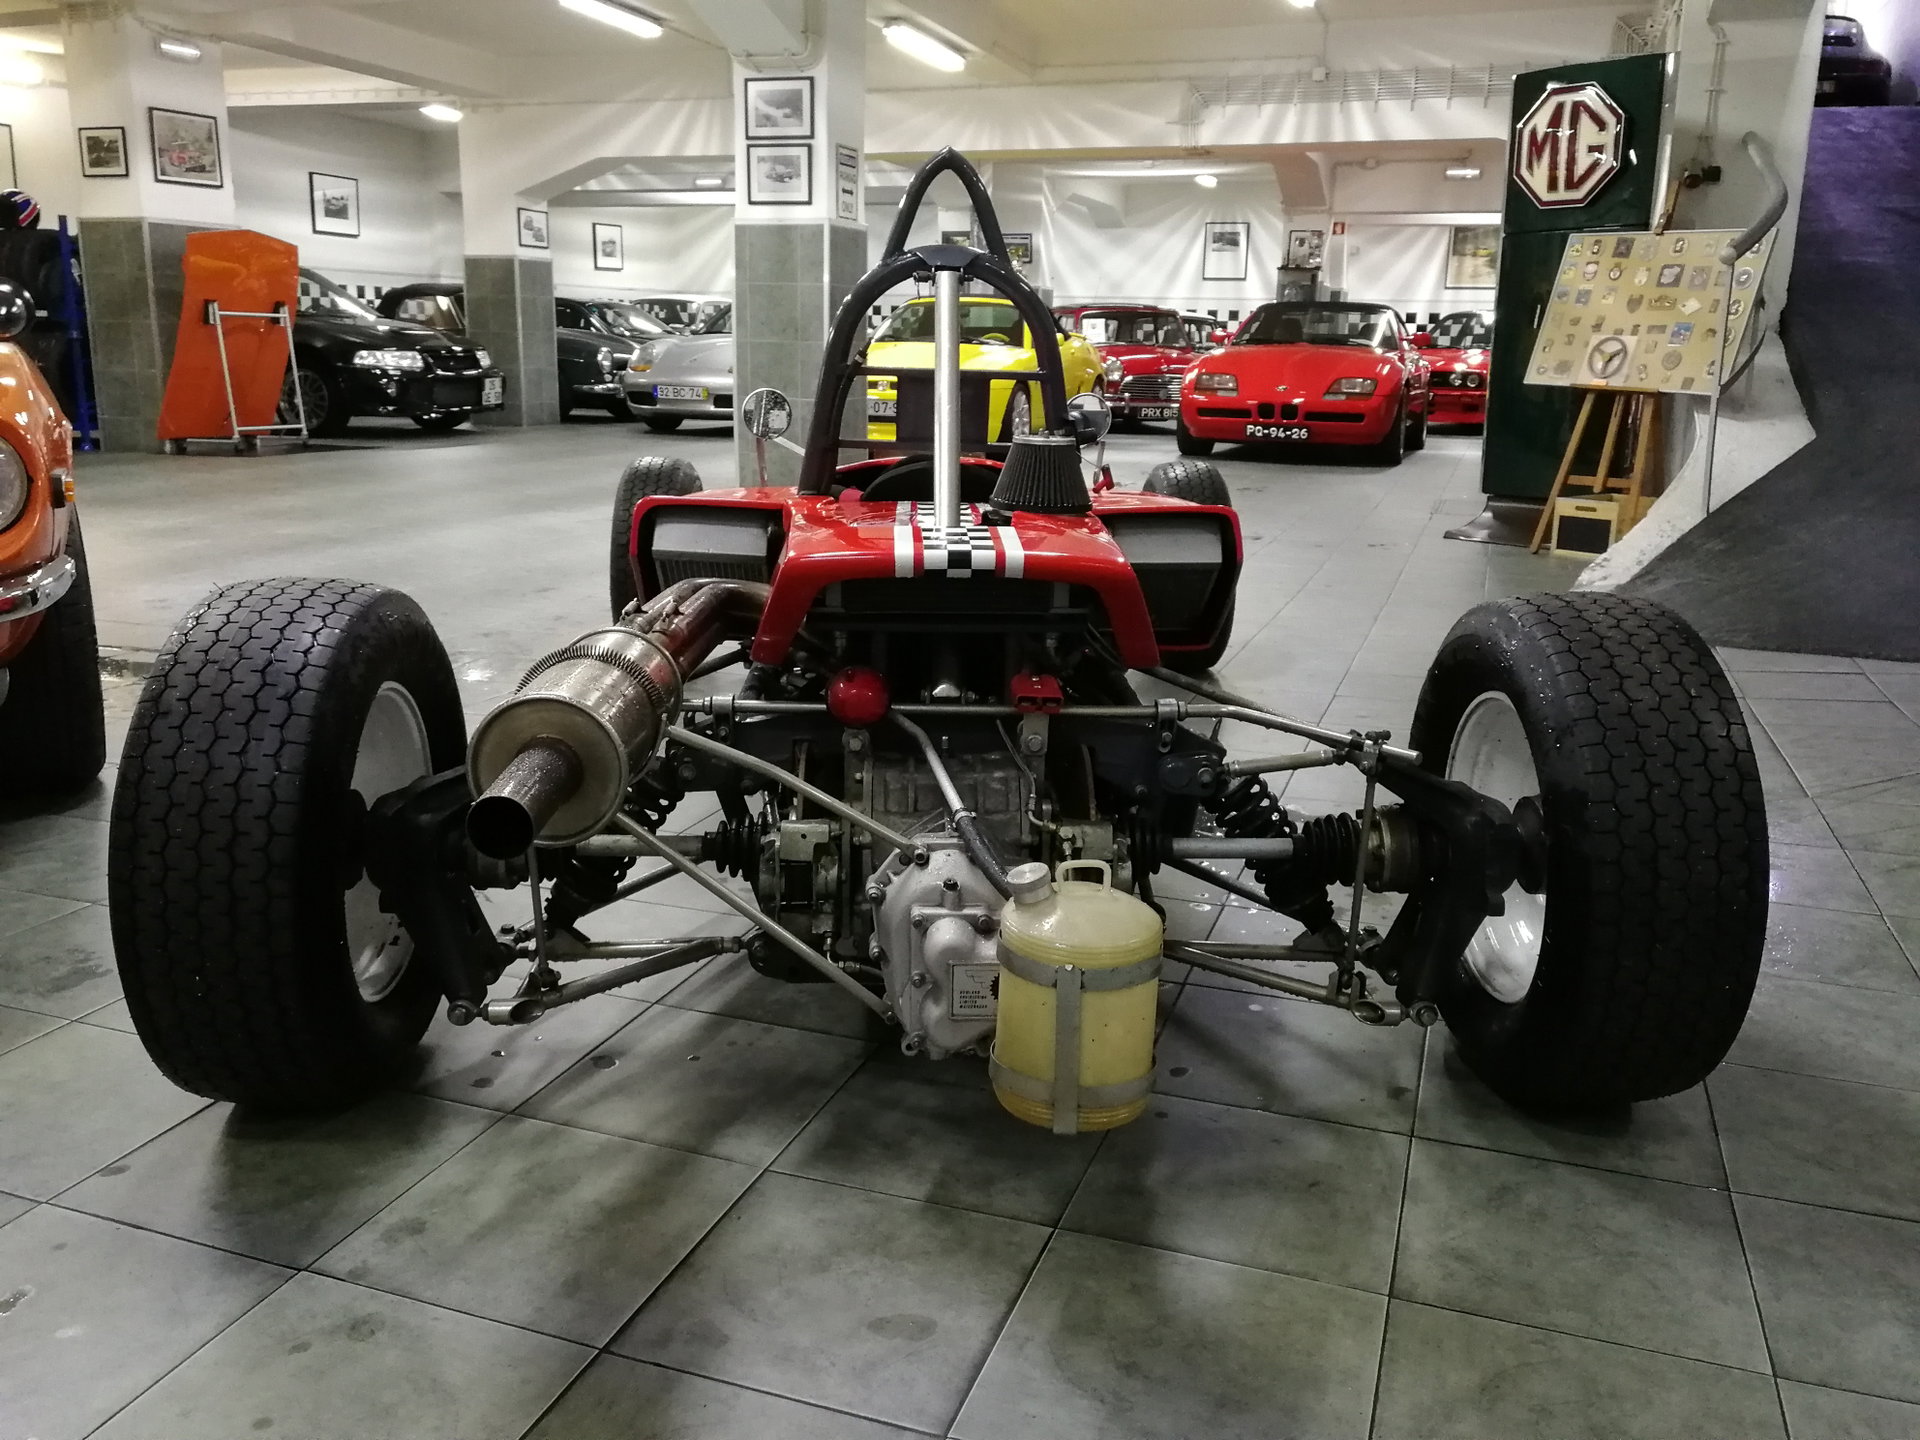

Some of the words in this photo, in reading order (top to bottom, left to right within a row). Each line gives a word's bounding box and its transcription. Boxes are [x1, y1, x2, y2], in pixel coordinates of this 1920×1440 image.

[1526, 100, 1607, 193] MG
[672, 387, 686, 398] BC
[689, 388, 701, 398] 74
[1141, 407, 1162, 417] PRX
[1163, 408, 1179, 417] 815
[1246, 424, 1309, 439] PQ-94-26
